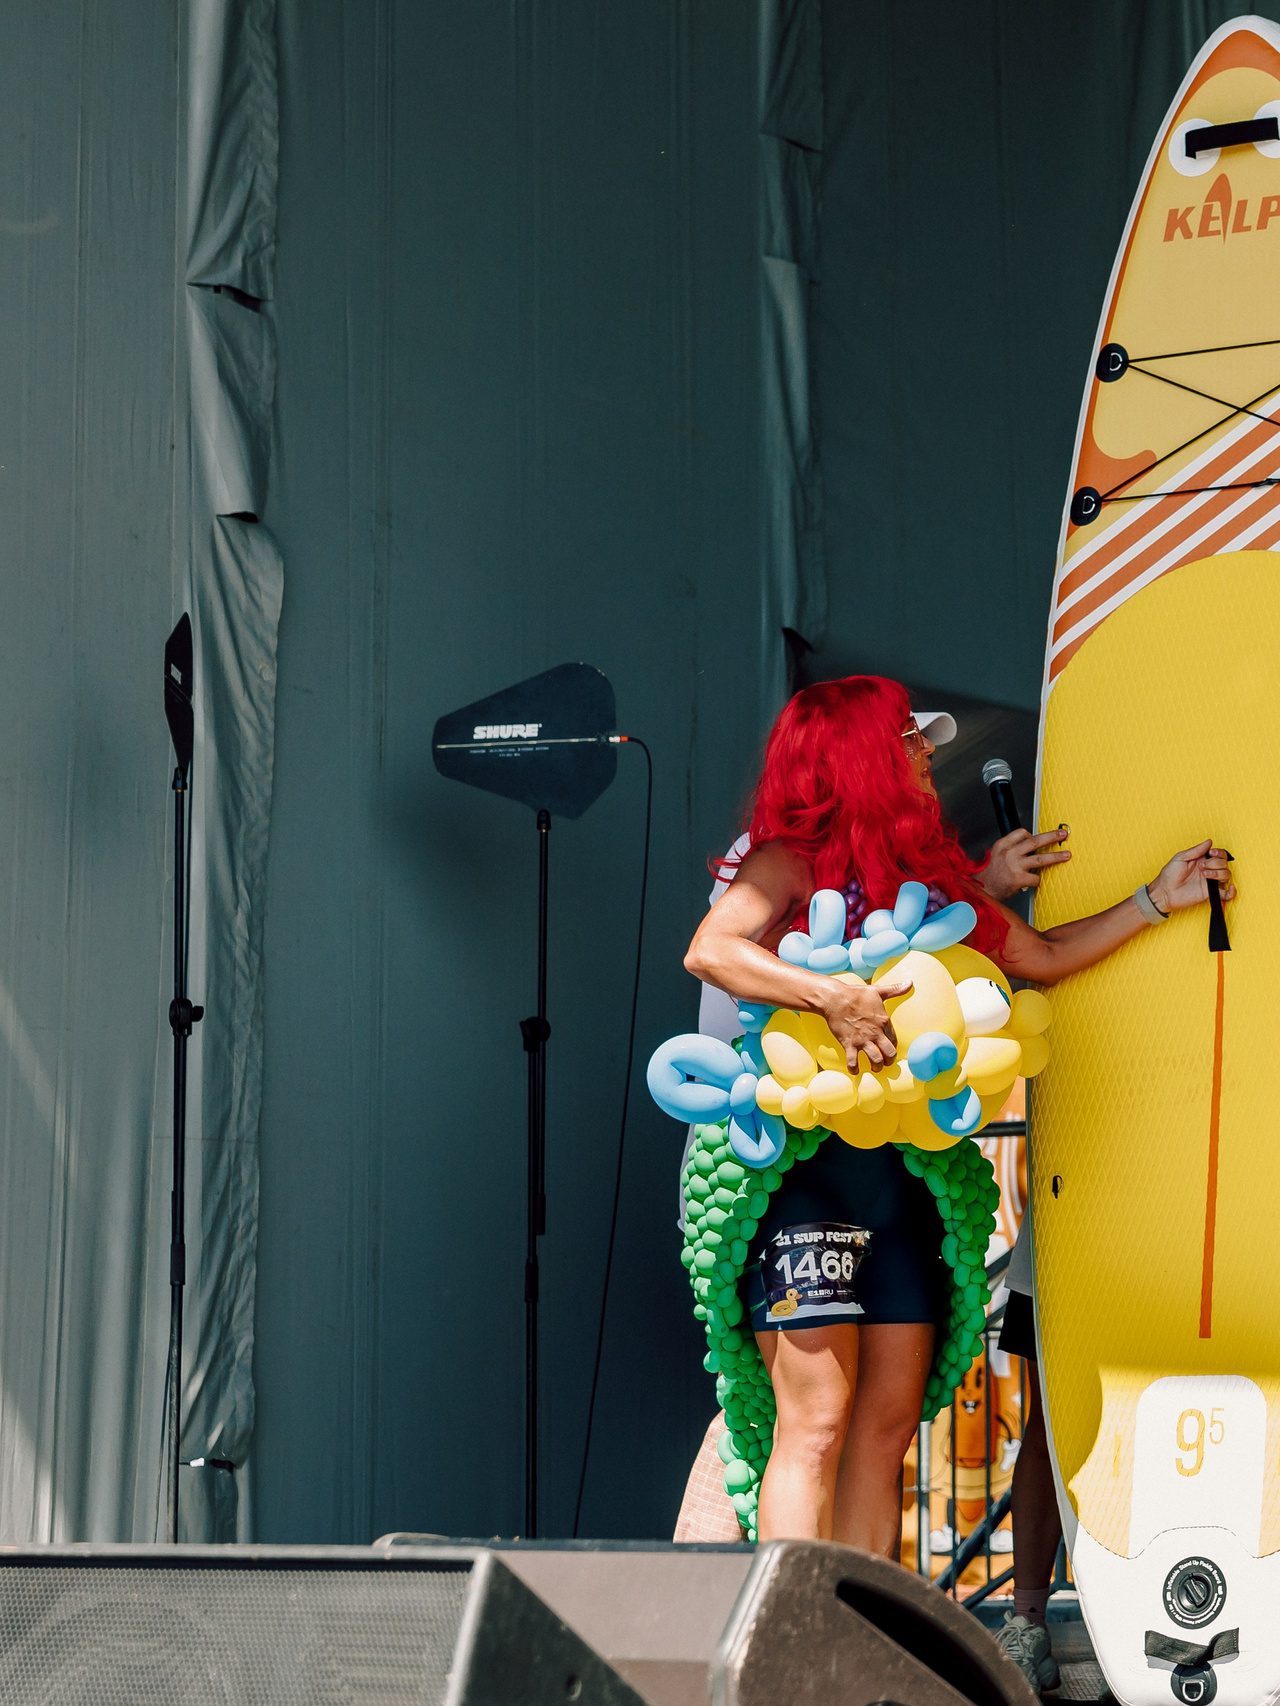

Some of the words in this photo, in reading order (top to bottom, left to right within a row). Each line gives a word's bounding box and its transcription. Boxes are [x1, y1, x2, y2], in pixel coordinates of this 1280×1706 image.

[473, 723, 539, 740] SHURE
[793, 1231, 824, 1245] SUP
[775, 1250, 854, 1285] 1466
